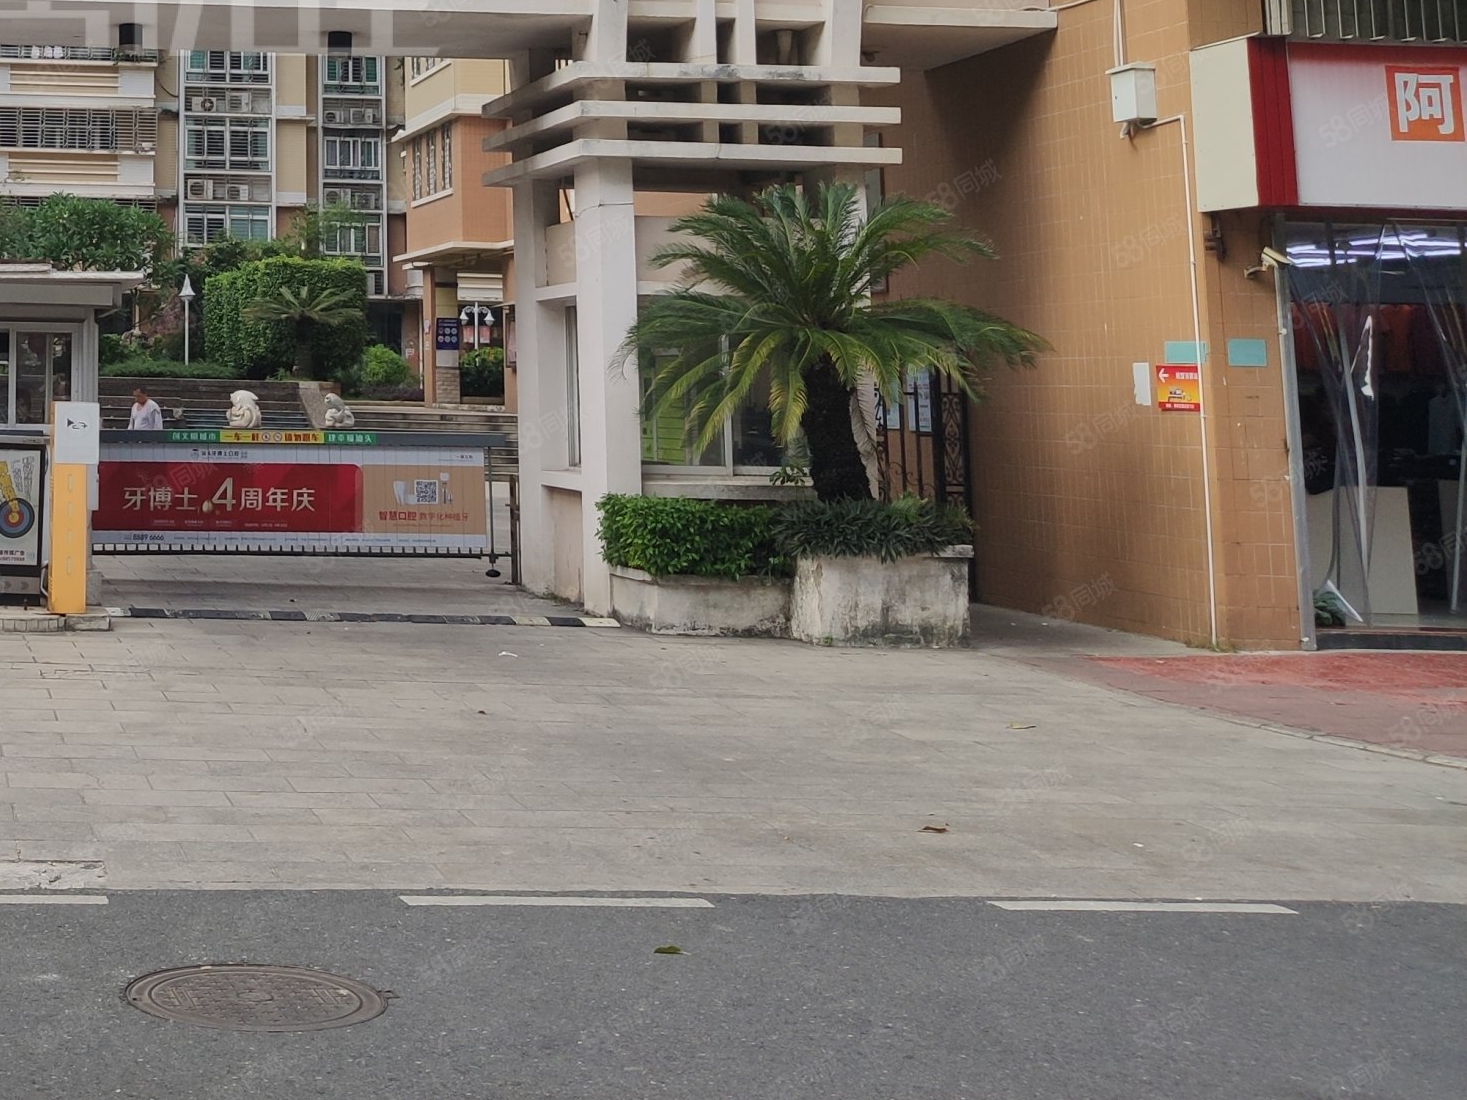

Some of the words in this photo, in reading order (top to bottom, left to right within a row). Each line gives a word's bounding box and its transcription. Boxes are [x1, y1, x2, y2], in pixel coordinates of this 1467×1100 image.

[1395, 71, 1454, 135] 阿
[122, 486, 198, 512] 牙博士
[378, 511, 417, 521] 智慧口腔
